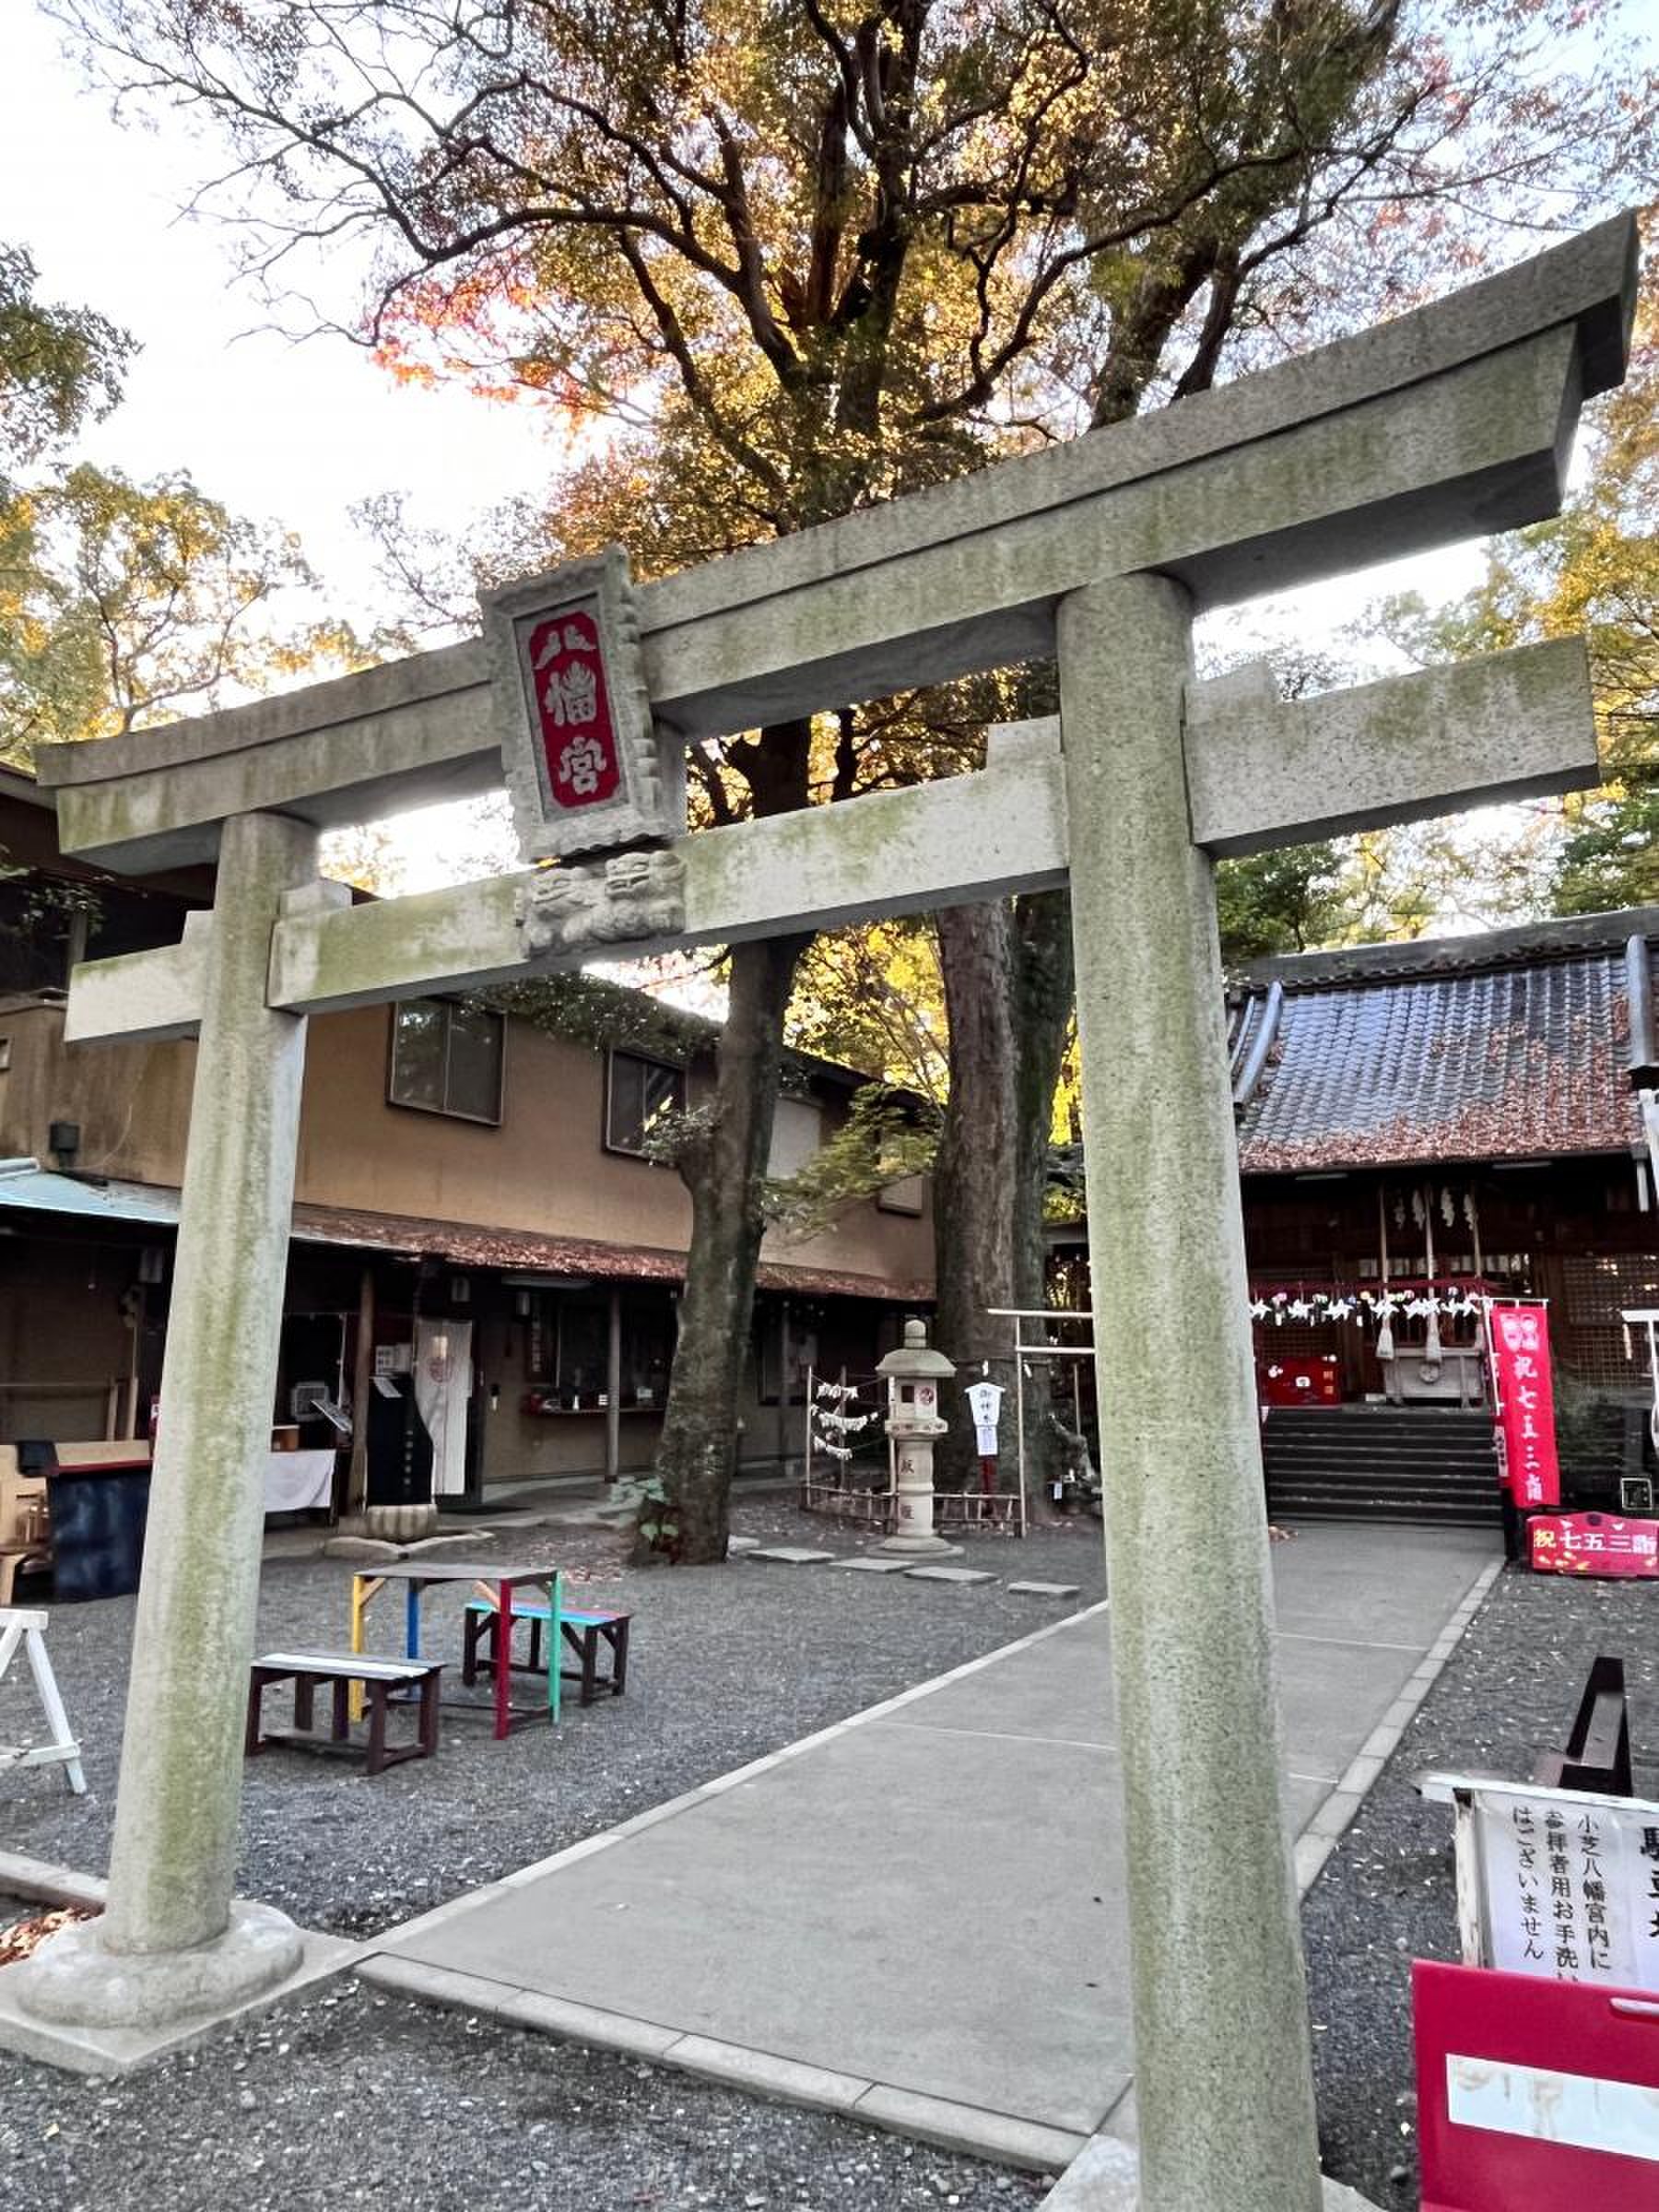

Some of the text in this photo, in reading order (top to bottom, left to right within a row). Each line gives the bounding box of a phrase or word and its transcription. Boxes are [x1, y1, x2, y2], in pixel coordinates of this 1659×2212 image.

[534, 623, 607, 795] 八幡宮
[1512, 1806, 1545, 1960] はございません
[1577, 1814, 1612, 1971] 小芝八幡宮内に
